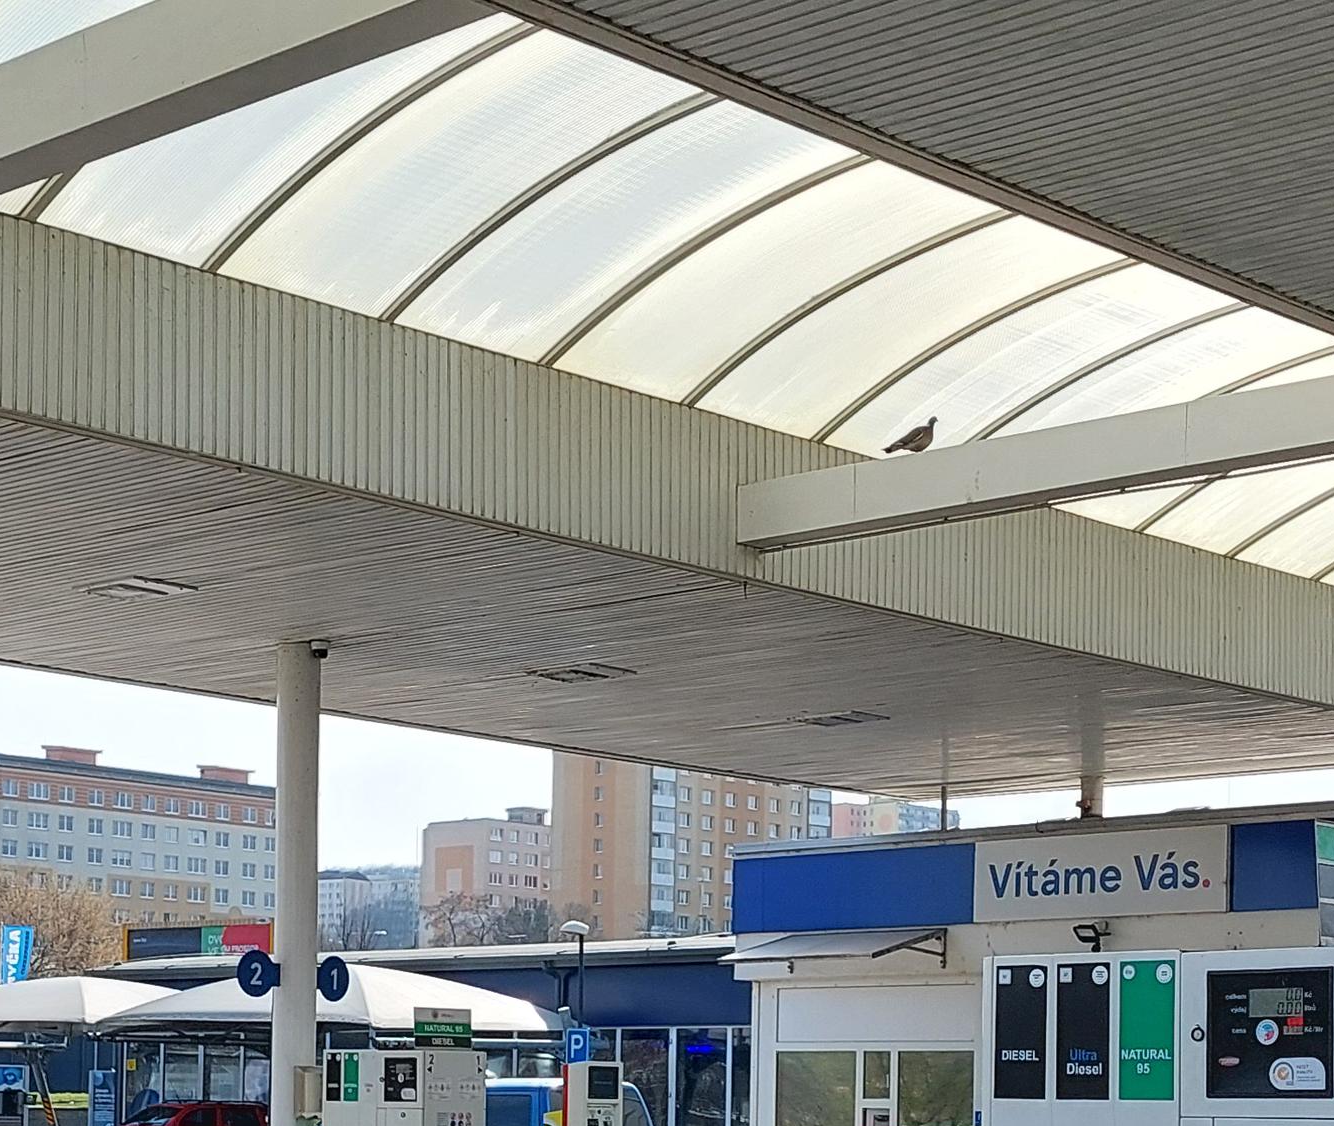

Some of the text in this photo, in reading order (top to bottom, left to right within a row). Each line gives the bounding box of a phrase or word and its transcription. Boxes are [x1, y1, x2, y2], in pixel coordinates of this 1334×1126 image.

[989, 851, 1210, 898] Vítáme Vás.
[250, 963, 262, 986] 2
[330, 968, 338, 990] 1
[424, 1023, 454, 1032] NATURAL
[432, 1038, 455, 1046] DIESEL
[570, 1034, 584, 1059] P
[429, 1054, 435, 1065] 2
[1001, 1050, 1039, 1061] DIESEL
[1070, 1048, 1097, 1061] Ultra
[1121, 1049, 1172, 1060] NATURAL
[1067, 1062, 1103, 1075] Diesel
[1136, 1063, 1151, 1074] 95
